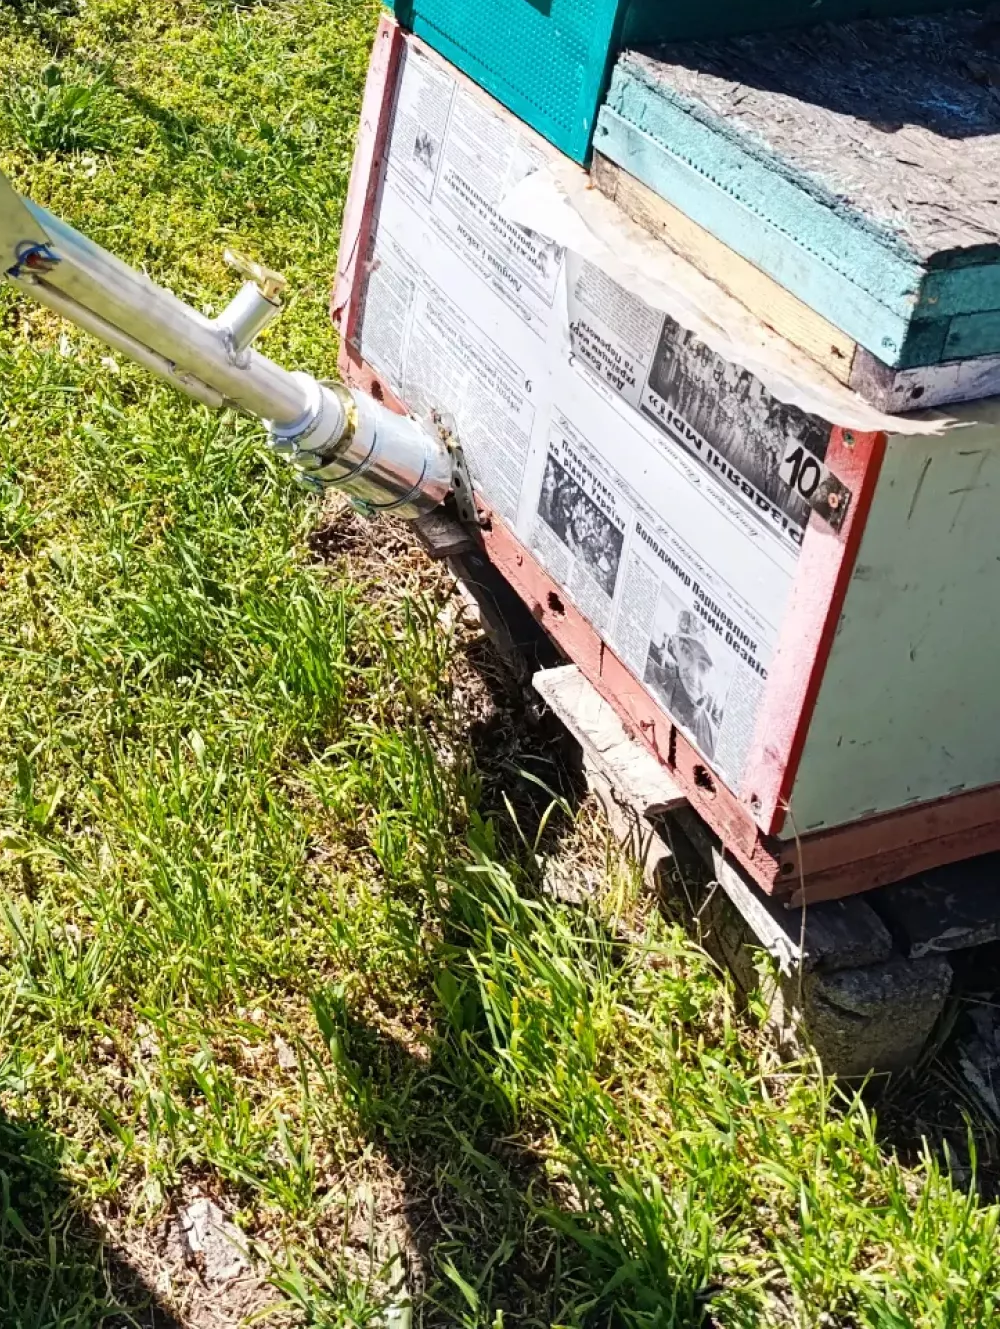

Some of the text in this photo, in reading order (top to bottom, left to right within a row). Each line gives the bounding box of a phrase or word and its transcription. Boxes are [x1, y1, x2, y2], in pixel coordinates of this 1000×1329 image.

[455, 222, 482, 253] закон
[485, 252, 523, 294] Людина
[566, 350, 577, 368] 2
[567, 319, 637, 390] українцям миру
[576, 339, 626, 394] Дай, Боже,
[622, 358, 635, 376] та
[524, 378, 533, 393] 6
[646, 389, 703, 454] мрії»
[547, 440, 627, 531] на рідну Україну
[560, 438, 618, 506] Повернулись
[704, 445, 804, 549] Різдвяні
[784, 446, 821, 499] 10
[633, 520, 693, 589] Володимир
[691, 597, 725, 637] зник
